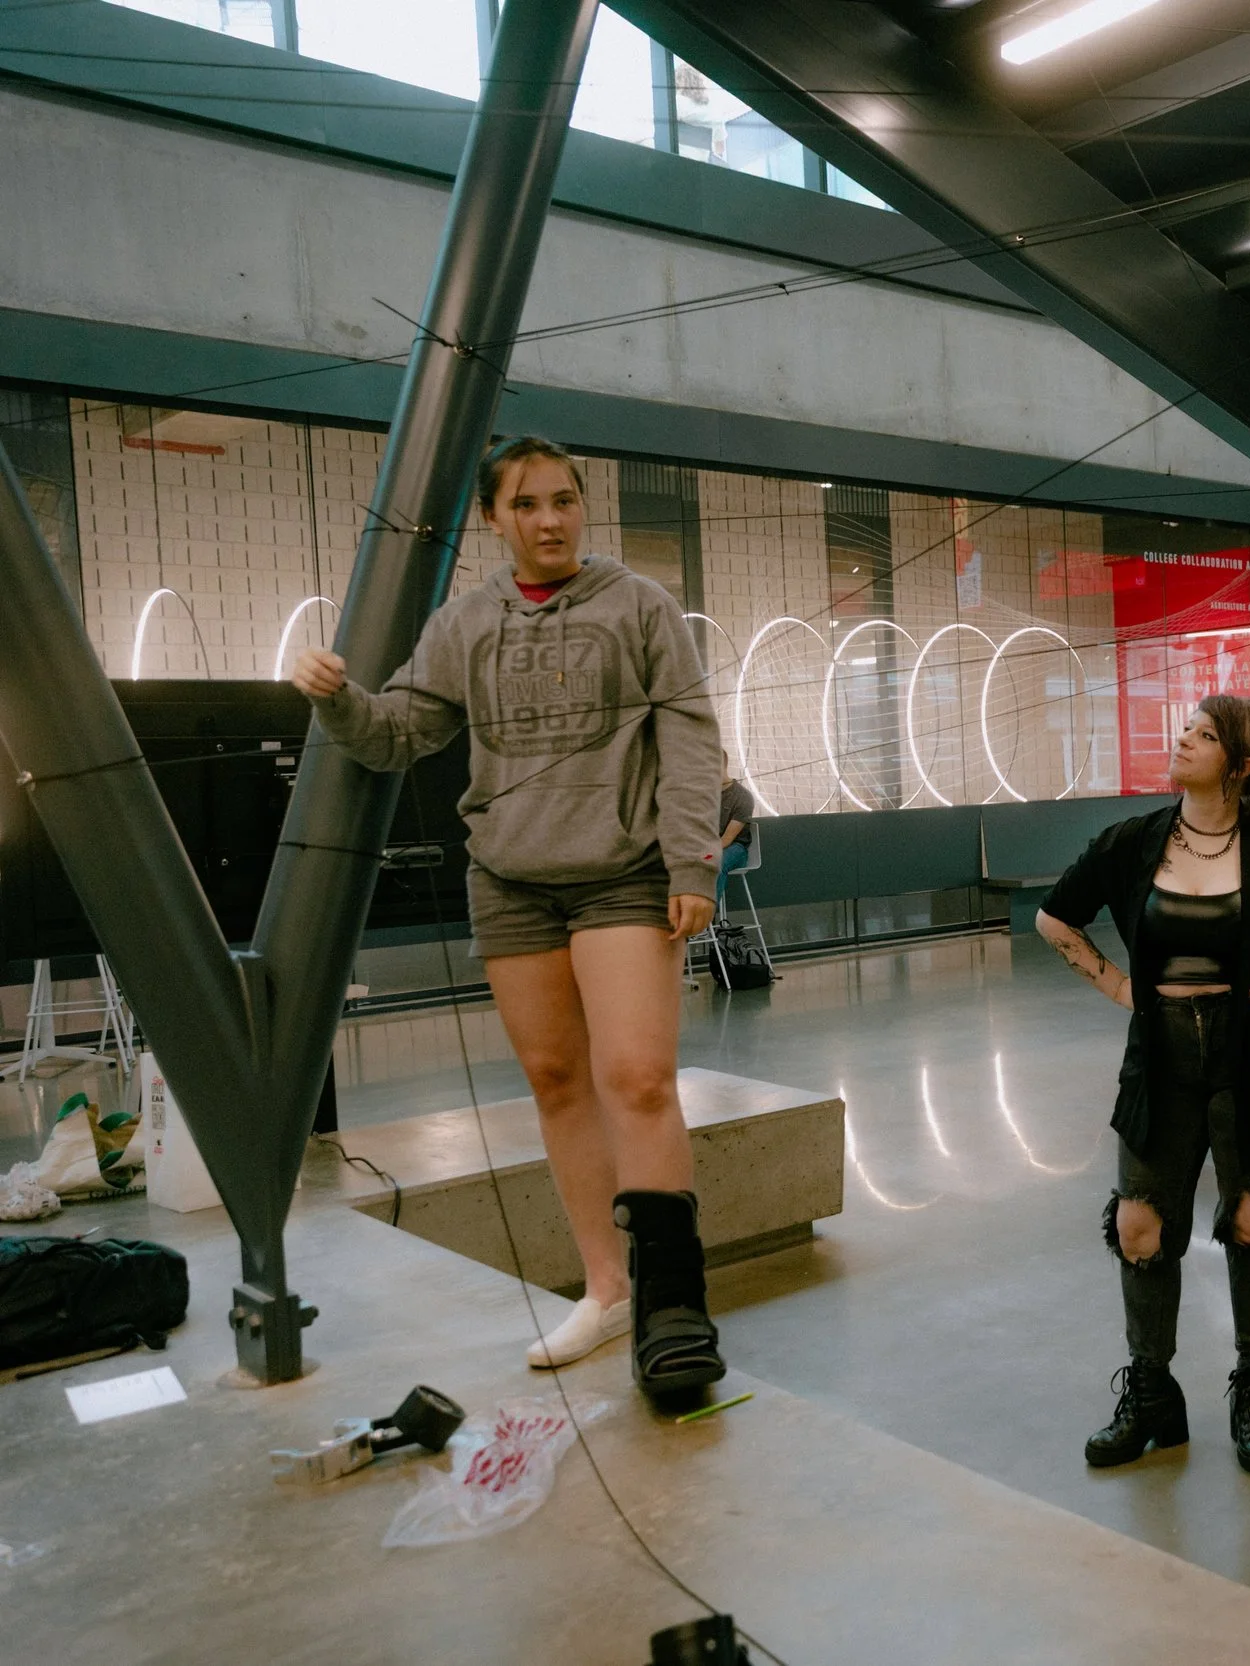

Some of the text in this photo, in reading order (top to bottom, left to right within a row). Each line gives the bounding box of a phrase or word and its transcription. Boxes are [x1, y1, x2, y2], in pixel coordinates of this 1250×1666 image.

[1143, 551, 1178, 565] COLLEGE
[1181, 555, 1242, 571] COLLABORATION
[500, 641, 594, 673] 967
[1184, 680, 1250, 692] MOTIATE
